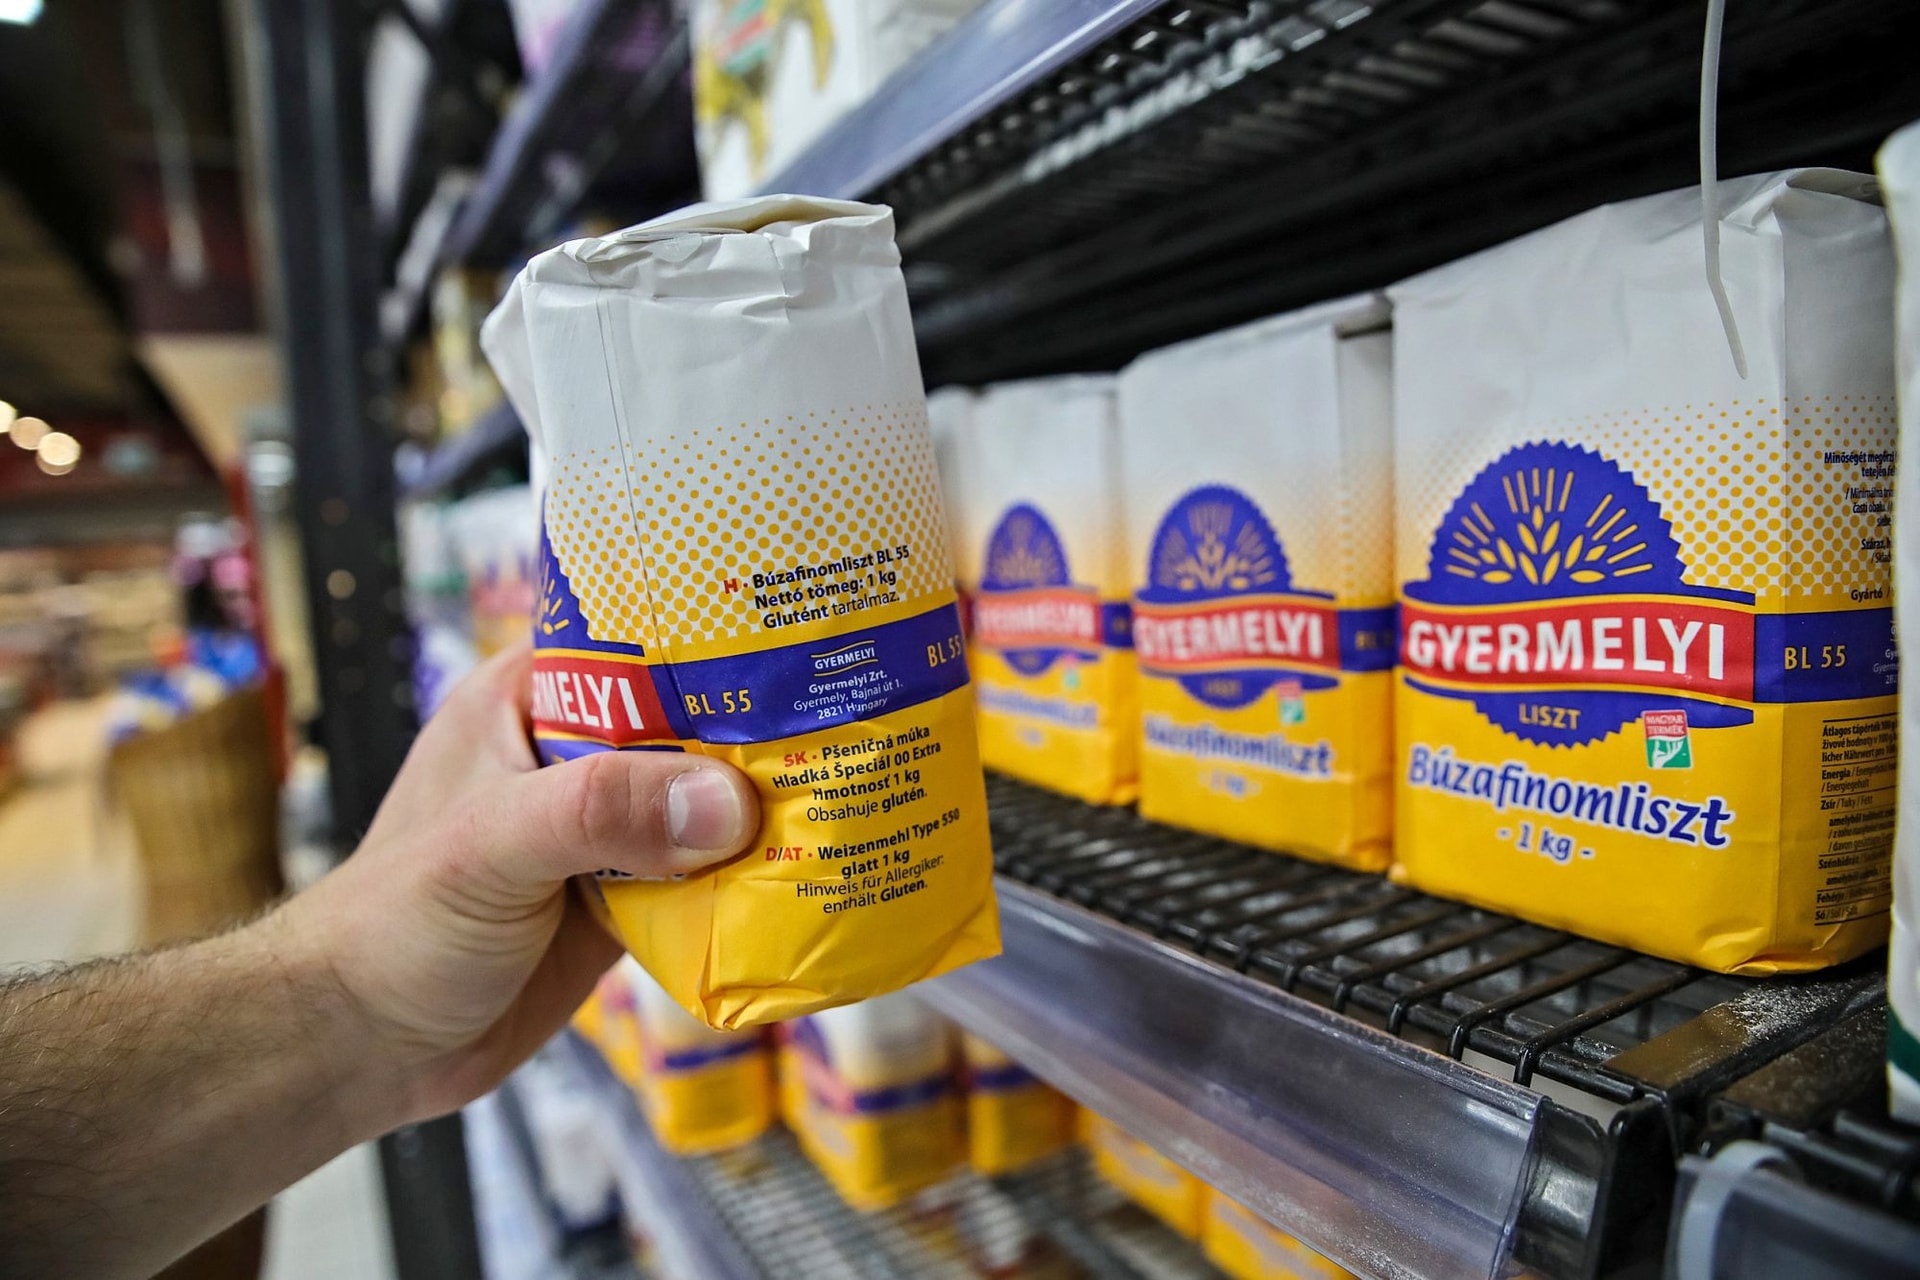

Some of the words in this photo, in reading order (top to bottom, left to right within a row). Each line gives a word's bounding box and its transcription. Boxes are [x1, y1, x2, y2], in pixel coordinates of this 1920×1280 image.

[723, 577, 739, 594] H
[752, 555, 874, 589] Búzafinomliszt
[876, 548, 895, 565] BL
[895, 545, 910, 561] 55
[754, 587, 803, 609] Nettó
[807, 576, 864, 601] tömeg:
[866, 573, 874, 587] 1
[879, 569, 897, 588] kg
[1850, 588, 1883, 603] Gyártó
[763, 605, 829, 629] Glutént
[831, 590, 900, 616] tartalmaz.
[814, 646, 876, 671] GYERMELYI
[926, 644, 947, 668] BL
[949, 634, 961, 659] 55
[1407, 617, 1725, 680] GYERMELYI
[1784, 646, 1812, 670] BL
[1821, 645, 1846, 668] 55
[793, 692, 850, 712] Gyermely,
[850, 685, 882, 702] Bajnai
[882, 680, 895, 694] út
[894, 678, 904, 690] 1.
[808, 673, 868, 695] Gyermelyi
[868, 669, 888, 683] Zrt.
[684, 694, 716, 716] BL
[725, 689, 753, 714] 55
[816, 705, 844, 721] 2821
[845, 697, 888, 715] Hungary
[1518, 703, 1581, 730] LISZT
[1645, 714, 1684, 725] MAGYAR
[783, 751, 808, 768] SK
[821, 734, 894, 760] Pšeničná
[896, 725, 930, 746] múka
[772, 766, 830, 789] Hladká
[833, 755, 891, 781] Špeciál
[894, 751, 910, 767] 00
[913, 741, 942, 761] Extra
[811, 773, 891, 801] Hmotnosť
[893, 773, 900, 786] 1
[904, 768, 921, 786] kg
[1407, 746, 1732, 847] Búzafinomliszt
[807, 799, 879, 822] Obsahuje
[881, 785, 928, 813] glutén.
[765, 846, 803, 862] D/AT
[817, 827, 911, 861] Weizenmehl
[911, 819, 940, 840] Type
[941, 808, 961, 826] 550
[1517, 824, 1530, 849] 1
[1540, 829, 1572, 860] kg
[796, 878, 859, 898] Hinweis
[862, 874, 883, 890] für
[884, 854, 945, 885] Allergiker:
[841, 857, 880, 880] glatt
[882, 855, 890, 867] 1
[893, 849, 911, 867] kg
[822, 891, 877, 914] enthält
[880, 878, 929, 903] Gluten.
